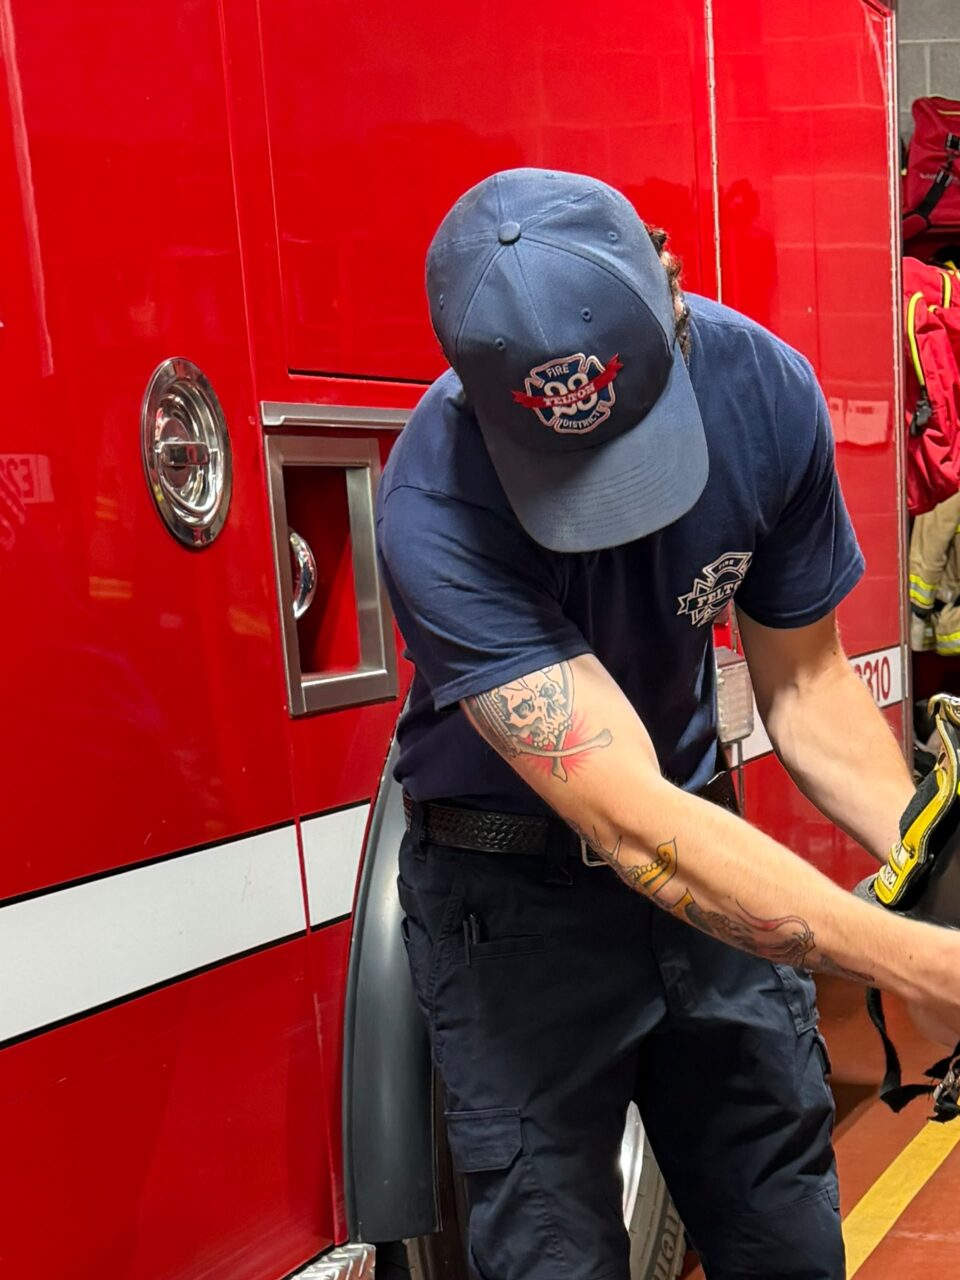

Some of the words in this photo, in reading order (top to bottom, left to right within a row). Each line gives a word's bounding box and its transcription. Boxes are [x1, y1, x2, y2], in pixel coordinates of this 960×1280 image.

[546, 363, 570, 378] FIRE
[543, 382, 596, 406] FELTON
[562, 410, 601, 429] DISTRICT
[718, 559, 735, 570] FIRE
